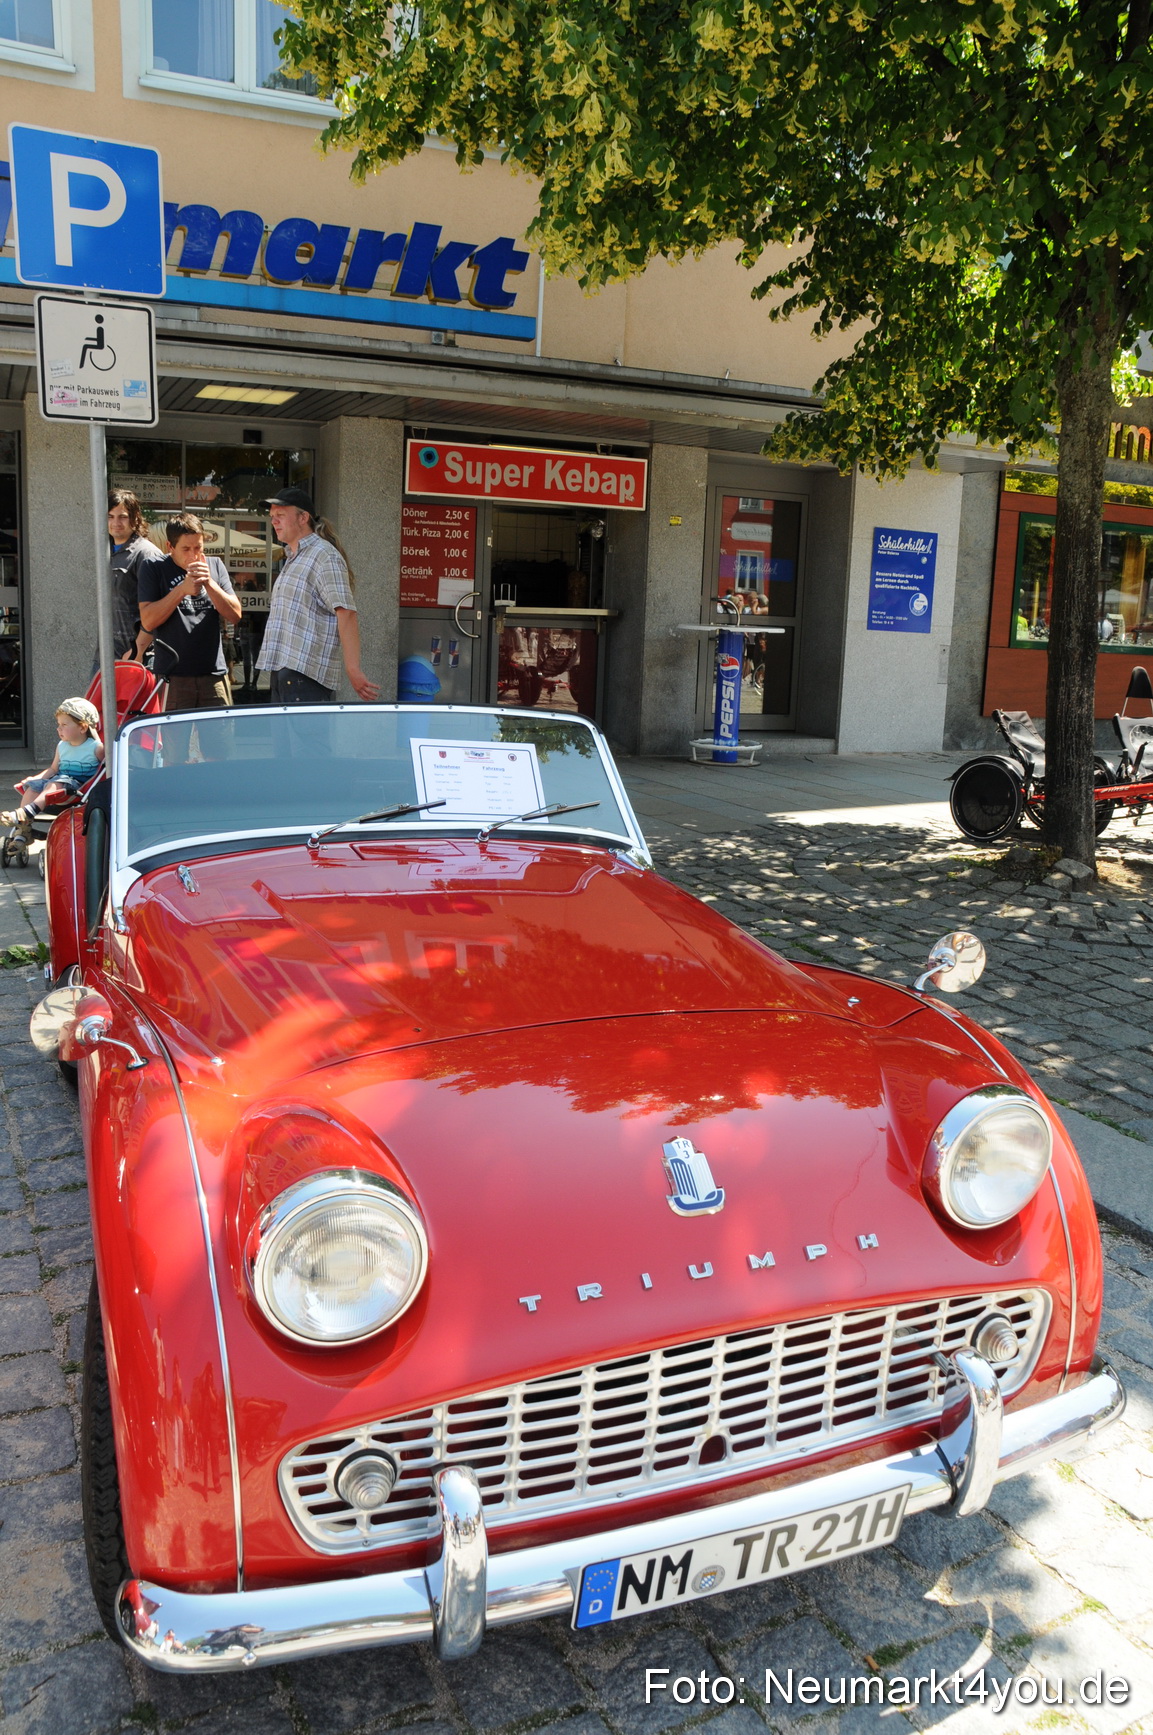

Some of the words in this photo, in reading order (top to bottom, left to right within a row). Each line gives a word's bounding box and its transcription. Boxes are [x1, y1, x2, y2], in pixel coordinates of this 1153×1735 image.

[49, 151, 127, 267] P
[77, 385, 120, 397] Parkausweis
[79, 397, 89, 406] im
[90, 398, 121, 411] Fahrzeug
[444, 451, 535, 493] Super
[544, 458, 636, 503] Kebap
[403, 507, 428, 518] Döner
[445, 510, 462, 520] 2,50
[464, 511, 470, 520] €
[402, 526, 420, 536] Türk.
[422, 527, 441, 537] Pizza
[444, 529, 462, 539] 2,00
[463, 530, 469, 539] €
[878, 534, 934, 555] Schülerhilfe!
[402, 546, 430, 557] Börek
[443, 548, 460, 558] 1,00
[461, 549, 467, 558] €
[229, 560, 267, 568] EDEKA
[400, 565, 433, 576] Getränk
[443, 567, 460, 577] 1,00
[461, 568, 467, 577] €
[720, 680, 735, 738] PEPSI
[674, 1140, 690, 1149] TR
[683, 1150, 690, 1159] 3
[518, 1232, 880, 1312] TRIUMPH
[617, 1549, 694, 1610] NM
[733, 1523, 798, 1580] TR
[804, 1492, 904, 1562] 21H
[589, 1598, 603, 1614] D
